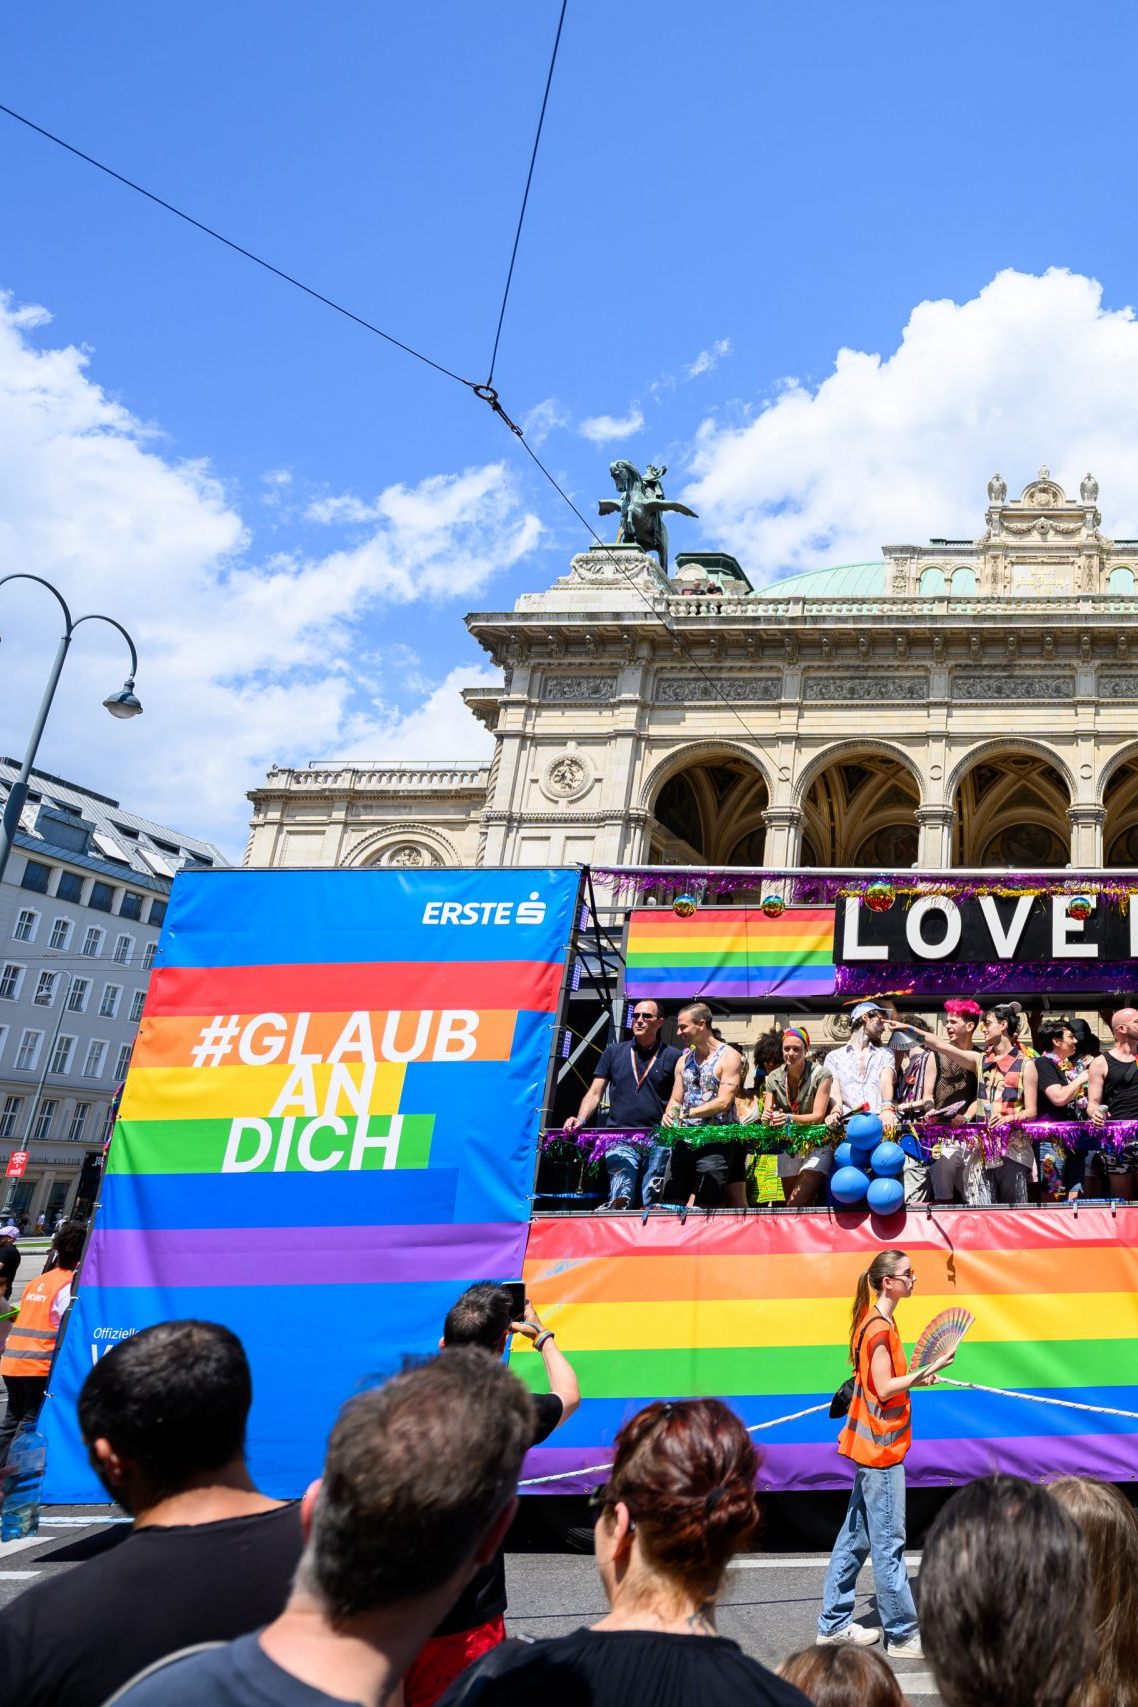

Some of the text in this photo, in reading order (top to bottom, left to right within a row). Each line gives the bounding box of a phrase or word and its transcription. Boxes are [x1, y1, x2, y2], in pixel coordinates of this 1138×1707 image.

[422, 901, 514, 925] ERSTE
[842, 895, 1099, 960] LOVE
[191, 1009, 480, 1067] #GLAUB
[267, 1060, 377, 1118] AN
[221, 1113, 404, 1173] DICH
[93, 1327, 140, 1340] Offiziell
